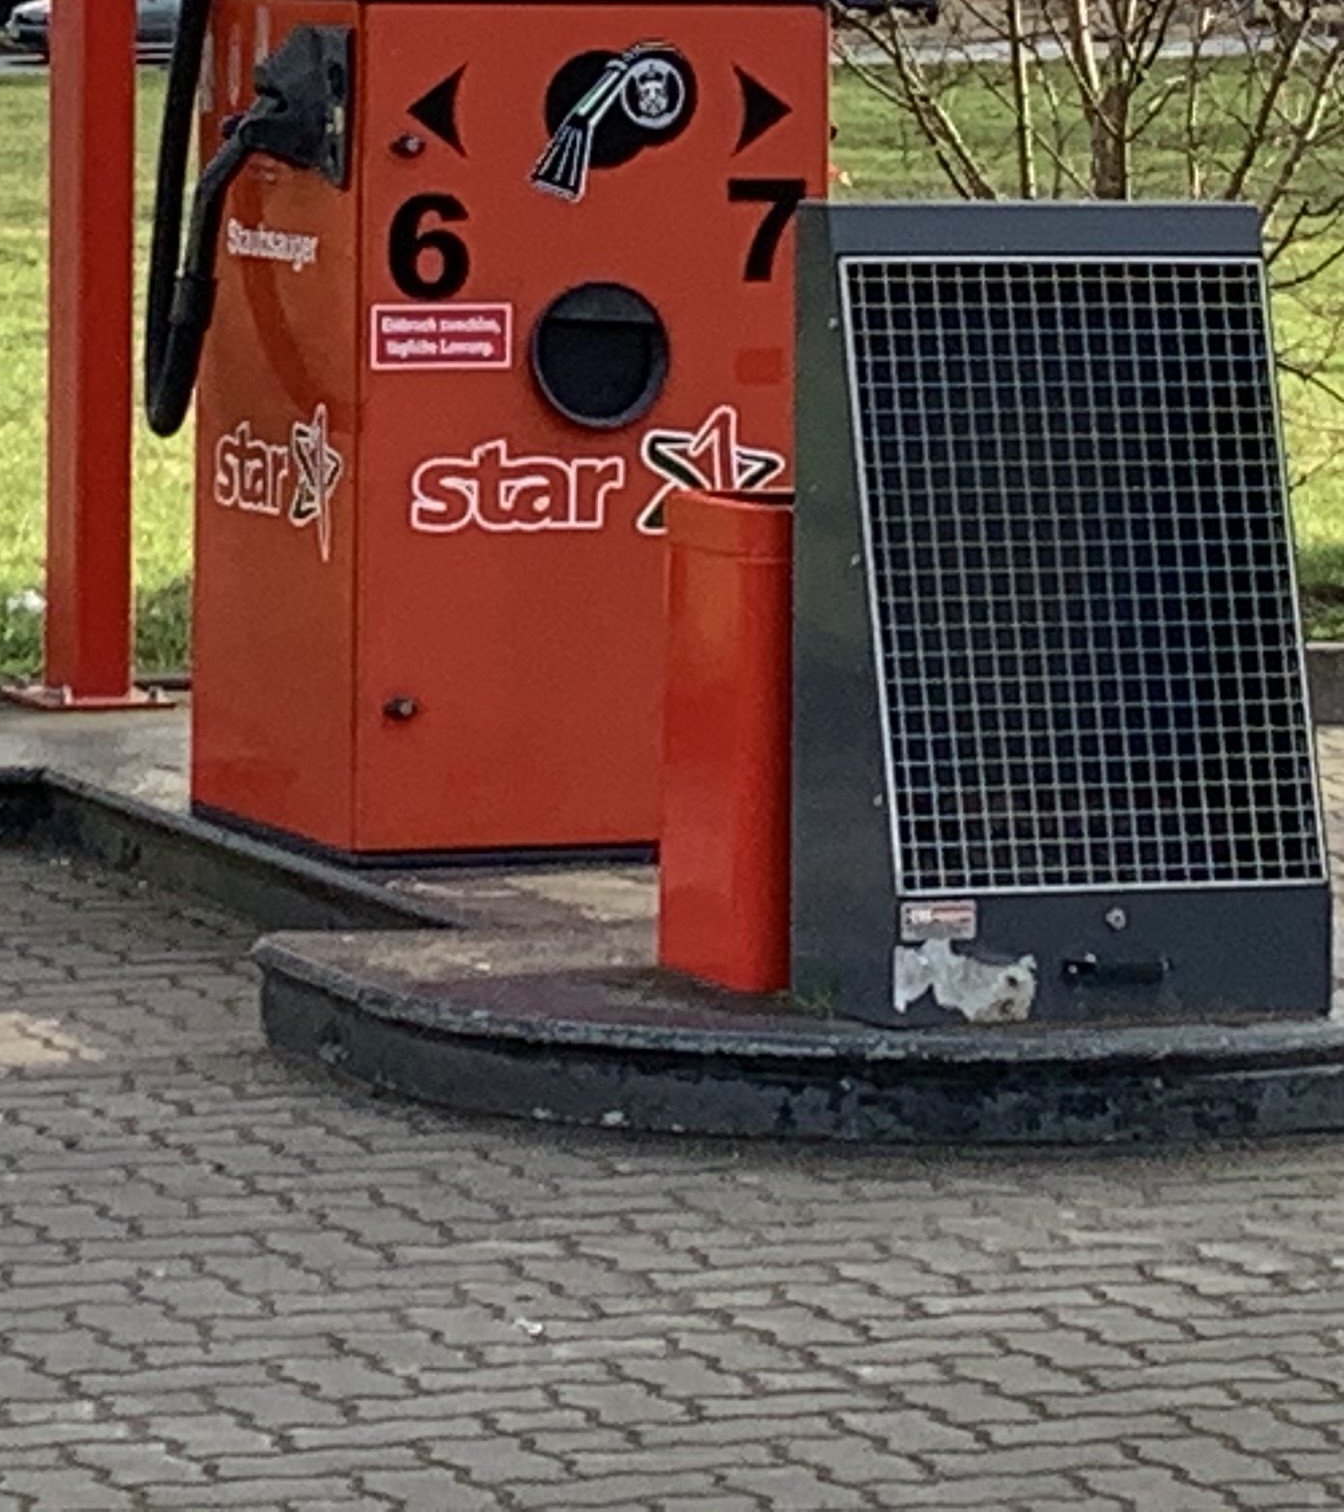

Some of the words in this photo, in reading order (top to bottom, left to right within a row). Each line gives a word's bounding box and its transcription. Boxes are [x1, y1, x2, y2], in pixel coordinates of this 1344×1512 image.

[388, 192, 471, 301] 6
[726, 178, 807, 283] 7
[214, 420, 289, 516] star
[411, 439, 625, 533] star
